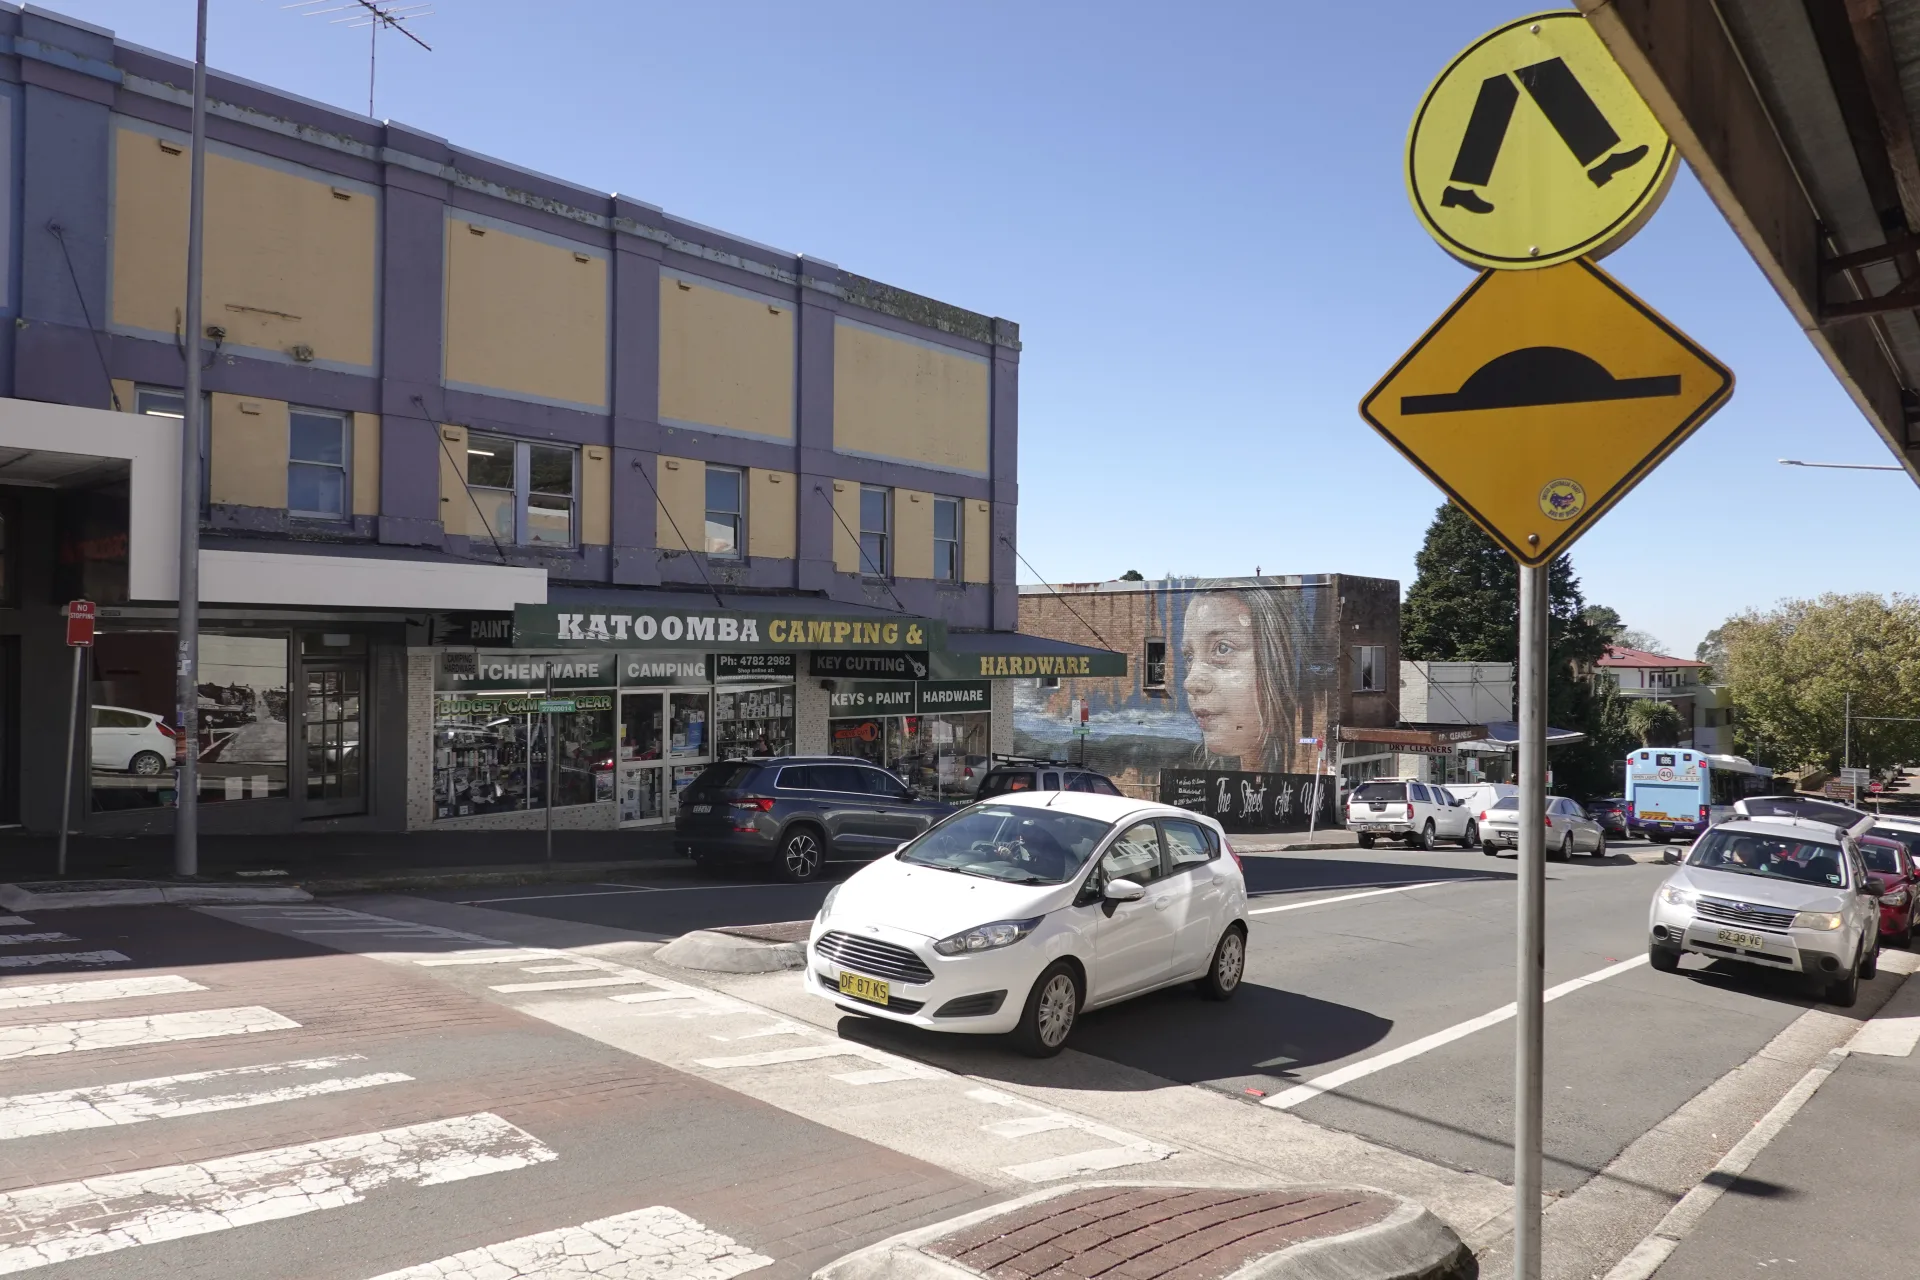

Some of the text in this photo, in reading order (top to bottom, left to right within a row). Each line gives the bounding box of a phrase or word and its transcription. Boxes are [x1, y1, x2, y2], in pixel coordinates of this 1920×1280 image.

[471, 620, 510, 638] PAINT
[557, 613, 923, 645] KATOOMBA CAMPING &
[447, 654, 473, 664] CAMPING
[720, 656, 791, 666] Ph: 4782 2982
[817, 657, 905, 671] KEY CUTTING
[980, 656, 1090, 676] HARDWARE
[444, 664, 477, 674] HARDWARE
[627, 663, 706, 678] CAMPING
[576, 696, 611, 709] GEAR
[831, 692, 911, 706] KEYS PAINT
[923, 690, 983, 703] HARDWARE
[440, 699, 500, 714] BUDGET
[1409, 744, 1452, 754] CLEANERS
[1216, 777, 1231, 813] The
[1239, 779, 1267, 818] Street
[1275, 781, 1293, 816] Art
[1719, 930, 1731, 941] BZ
[1749, 934, 1762, 946] VC
[841, 974, 854, 989] DF
[857, 978, 870, 995] 87
[873, 982, 887, 999] KS
